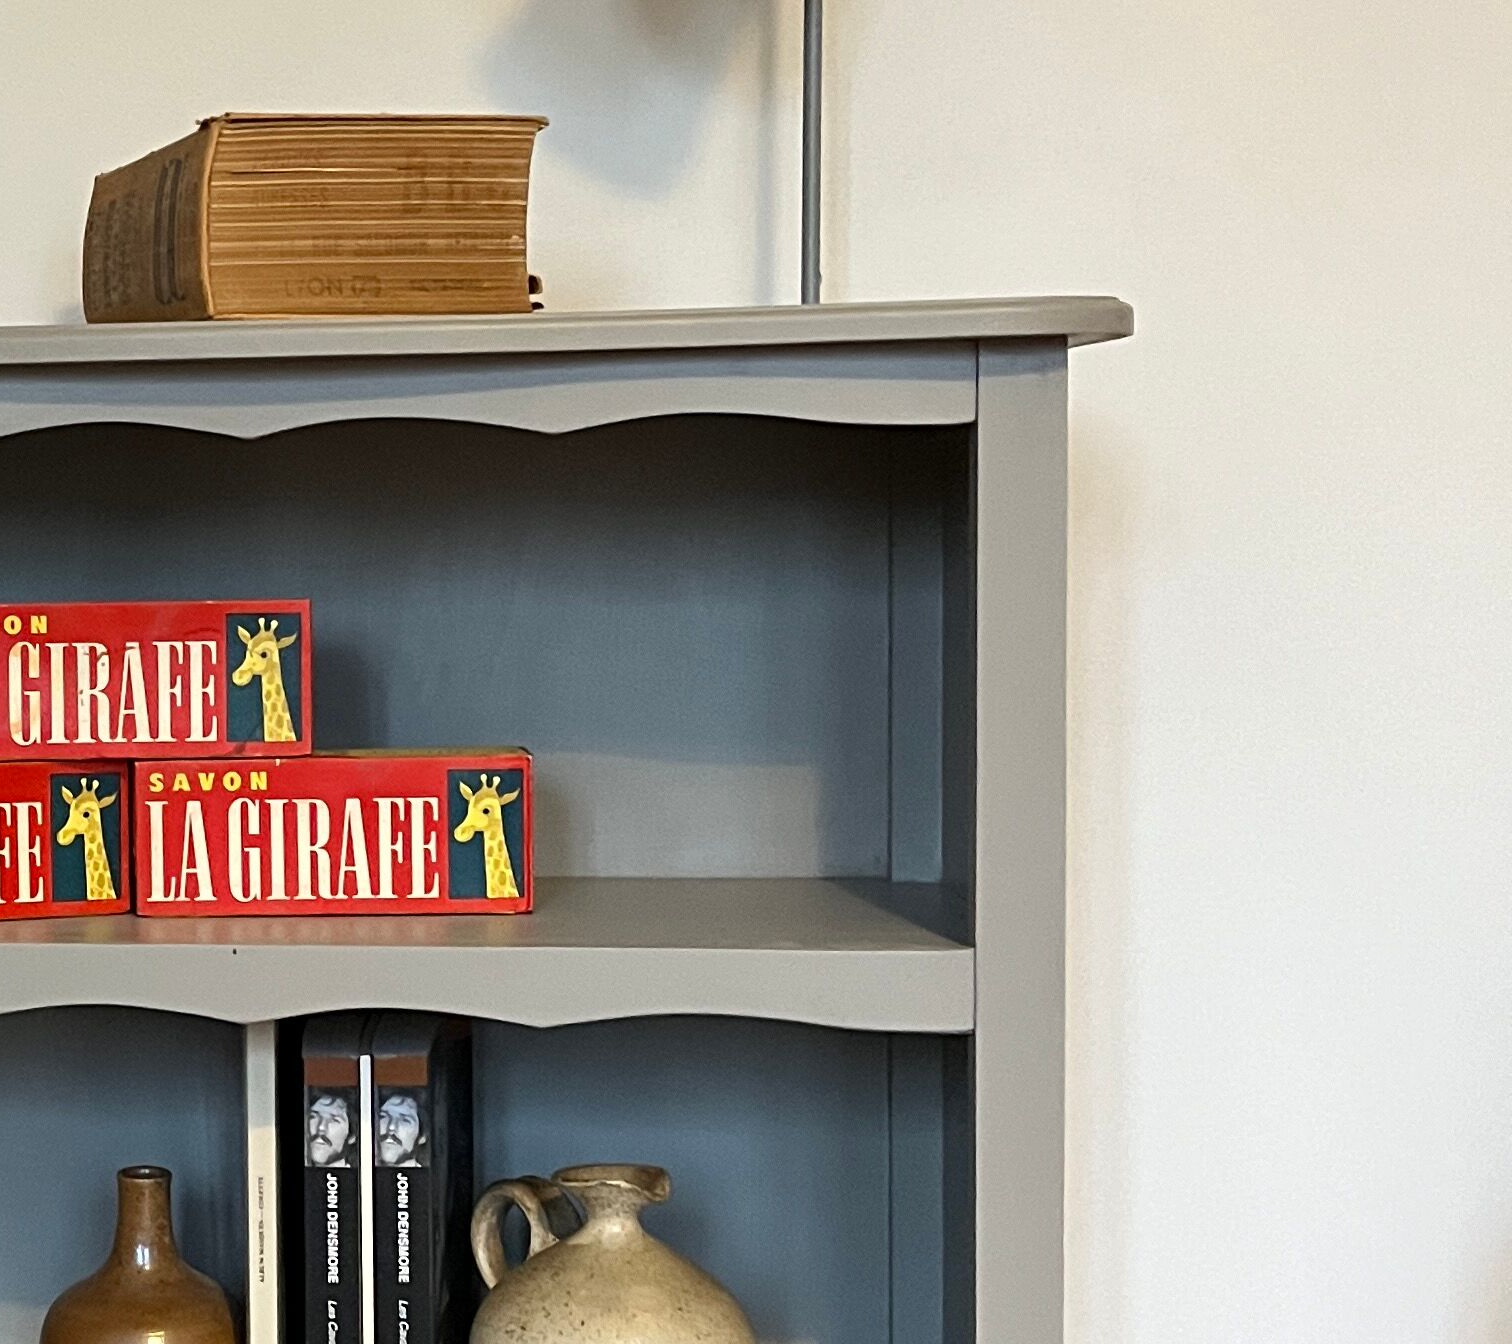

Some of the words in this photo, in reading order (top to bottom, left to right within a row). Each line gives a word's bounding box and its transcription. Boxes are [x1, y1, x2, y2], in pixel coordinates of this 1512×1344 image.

[8, 640, 218, 746] GIRAFE
[149, 770, 269, 793] SAVON
[144, 799, 219, 903] LA
[227, 796, 441, 903] GIRAFE
[327, 1172, 339, 1208] JOHN
[396, 1172, 408, 1208] JOHN
[327, 1211, 340, 1284] DENSMORE
[396, 1211, 409, 1284] DENSMORE
